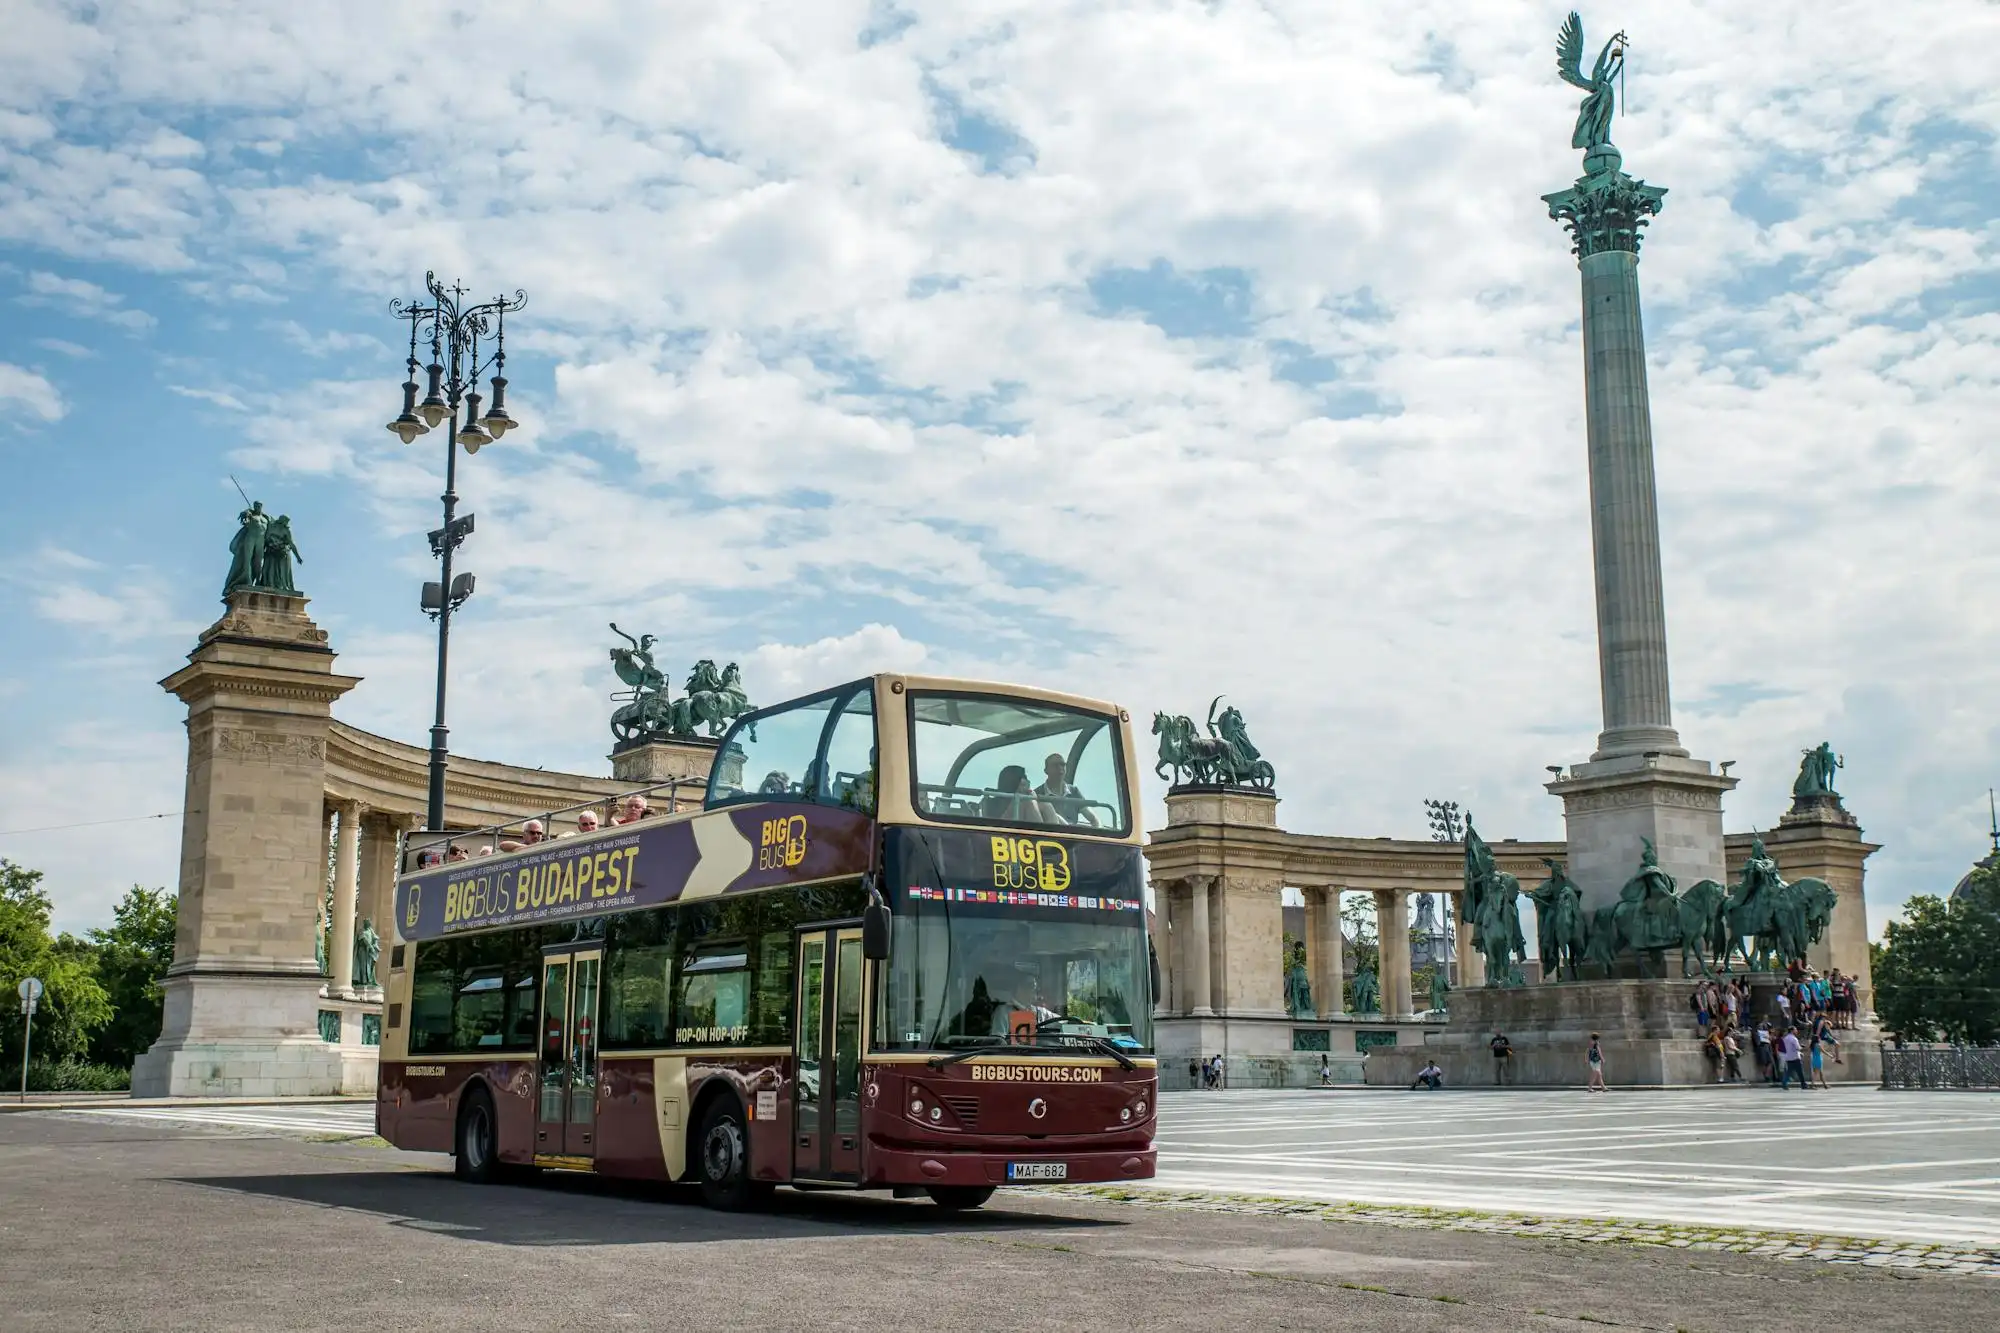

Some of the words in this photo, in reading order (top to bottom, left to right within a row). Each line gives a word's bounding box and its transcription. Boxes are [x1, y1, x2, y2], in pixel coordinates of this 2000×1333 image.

[594, 842, 603, 851] THE
[603, 840, 614, 849] MAIN
[614, 834, 641, 847] SYNAGOGUE
[762, 817, 787, 846] BIG
[760, 845, 785, 870] BUS
[991, 836, 1036, 864] BIG
[516, 846, 640, 910] BUDAPEST
[994, 863, 1038, 889] BUS
[534, 908, 547, 918] ISLAND
[576, 901, 594, 912] BASTION
[597, 899, 605, 908] THE
[606, 897, 620, 907] OPERA
[620, 895, 636, 904] HOUSE
[675, 1027, 708, 1043] HOP-ON
[709, 1025, 748, 1042] HOP-OFF
[972, 1065, 1102, 1082] BIGBUSTOURS.COM
[1016, 1165, 1065, 1177] MAF-682
